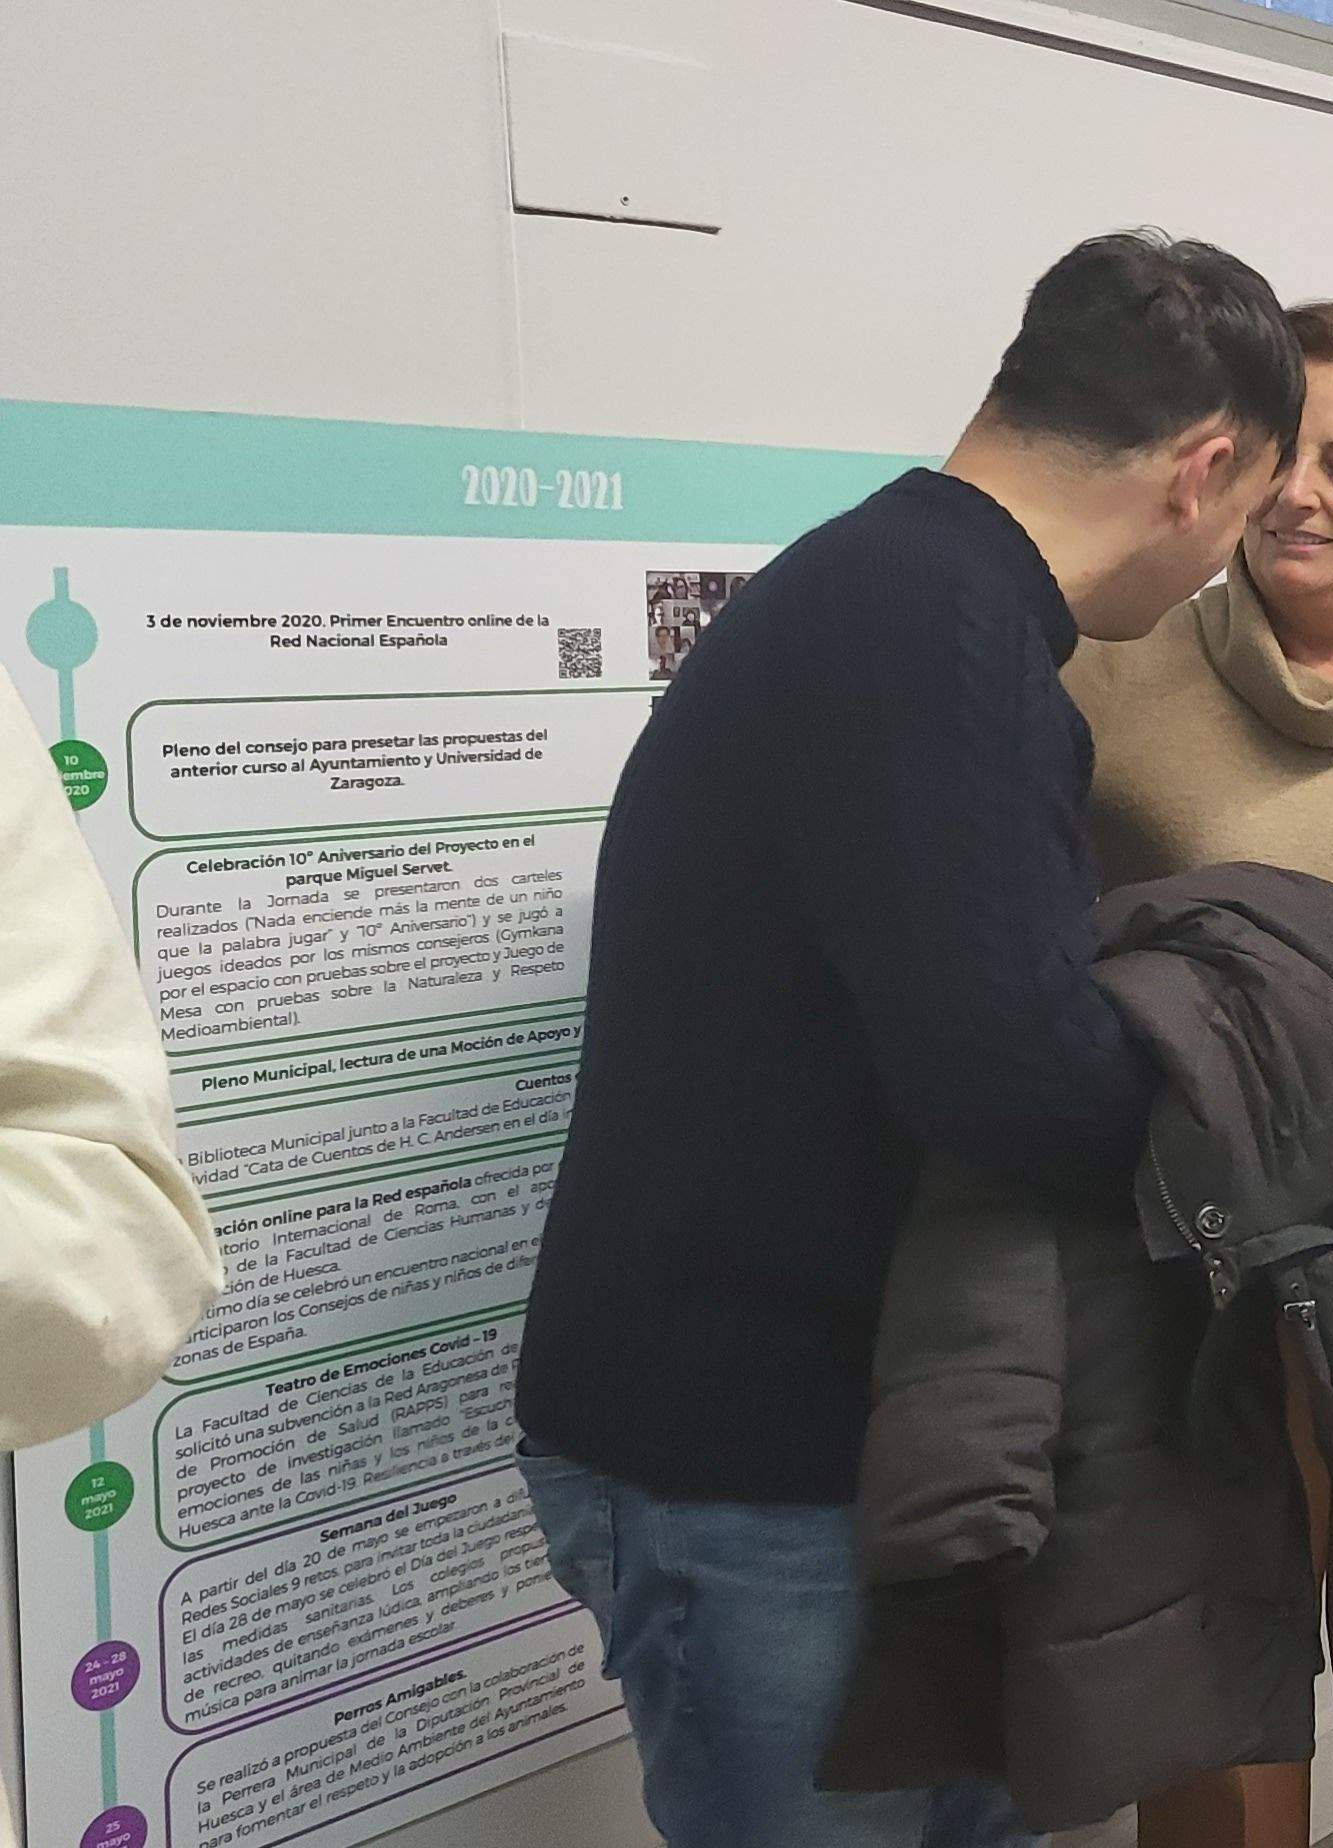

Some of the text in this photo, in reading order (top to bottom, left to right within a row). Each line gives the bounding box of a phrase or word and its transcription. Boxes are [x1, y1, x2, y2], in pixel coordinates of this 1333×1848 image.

[462, 464, 623, 510] 2020-2021
[146, 613, 550, 628] 3 de noviembre 2020. Primer Encuentro online de la
[270, 633, 448, 650] Red Nacional Española
[162, 728, 548, 758] Pleno del consejo para presetar las propuestas del
[63, 755, 79, 766] 10
[170, 747, 543, 778] anterior curso al Ayuntamiento y Universidad de
[64, 784, 90, 796] 020
[330, 776, 405, 791] Zaragoza.
[186, 854, 286, 874] Celebración
[317, 844, 405, 864] Aniversario
[408, 842, 431, 856] del
[436, 839, 499, 855] Proyecto
[502, 838, 520, 849] en
[523, 834, 535, 847] el
[286, 861, 453, 890] parque Miguel Servet.
[156, 869, 562, 919] Durante la Jornada se presentaron dos carteles
[157, 919, 238, 939] realizados
[302, 906, 373, 924] enciende
[379, 902, 410, 916] más
[416, 900, 428, 913] la
[434, 897, 480, 911] mente
[486, 893, 504, 906] de
[510, 893, 528, 903] un
[534, 887, 563, 900] niño
[158, 946, 190, 962] que
[198, 942, 212, 955] la
[222, 936, 280, 956] palabra
[340, 930, 349, 943] y
[482, 915, 491, 928] y
[497, 912, 512, 923] se
[518, 906, 549, 924] jugó
[555, 907, 563, 917] a
[157, 925, 564, 984] juegos ideados por los mismos consejeros (Gymkana
[160, 941, 564, 1004] por el espacio con pruebas sobre el proyecto y Juego de
[160, 961, 565, 1021] Mesa con pruebas sobre la Naturaleza y Respeto
[202, 1026, 581, 1091] Pleno Municipal, lectura de una Moción de Apoyo y
[516, 1074, 572, 1092] Cuentos
[188, 1144, 266, 1167] Biblioteca
[271, 1127, 345, 1152] Municipal
[347, 1123, 387, 1142] junto
[390, 1121, 399, 1132] a
[402, 1117, 415, 1129] la
[418, 1104, 479, 1127] Facultad
[481, 1102, 500, 1116] de
[173, 1347, 219, 1368] zonas
[222, 1340, 244, 1355] de
[265, 1376, 316, 1396] Teatro
[320, 1368, 340, 1383] de
[343, 1348, 427, 1377] Emociones
[430, 1334, 470, 1355] Covid
[482, 1328, 497, 1342] 19
[91, 1476, 106, 1488] 12
[81, 1489, 117, 1506] mayo
[85, 1502, 113, 1520] 2021
[320, 1494, 457, 1543] Semana del Juego
[89, 1668, 124, 1687] mayo
[91, 1682, 120, 1700] 2021
[334, 1670, 468, 1725] Perros Amigables.
[198, 1678, 586, 1834] Huesca y el área de Medio Ambiente del Ayuntamiento
[96, 1832, 132, 1848] mayo
[105, 1820, 121, 1835] 25
